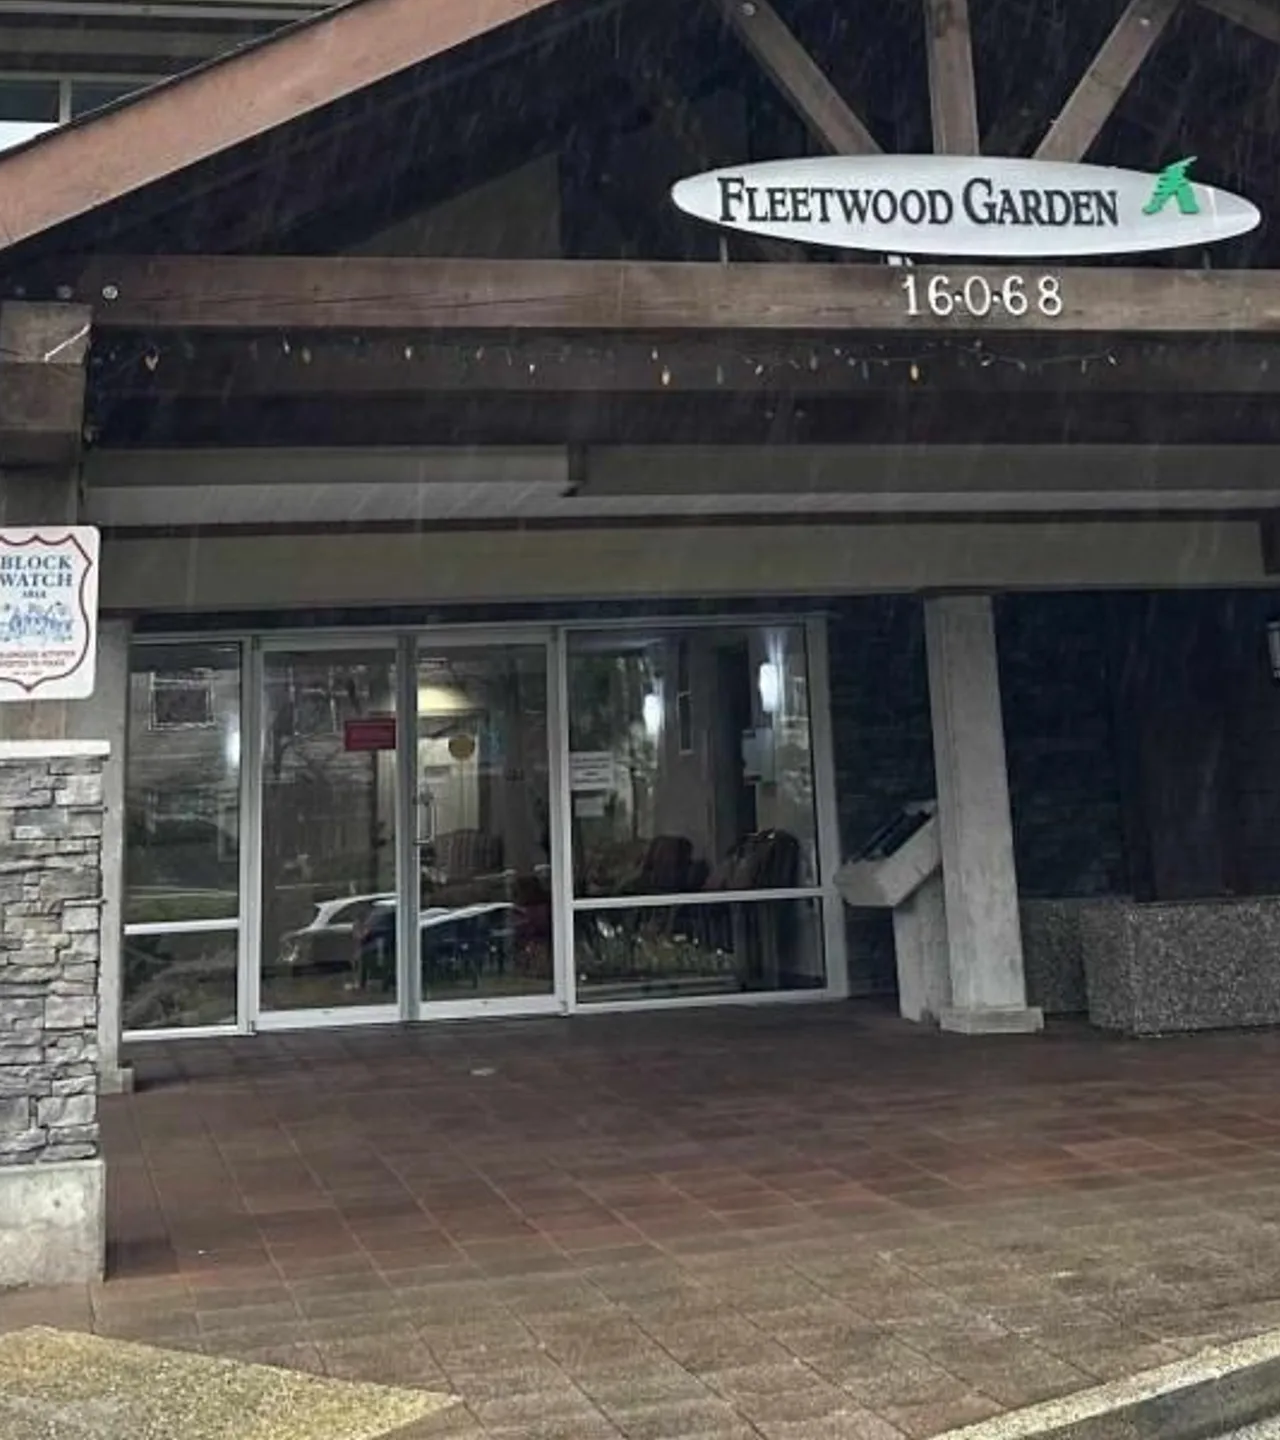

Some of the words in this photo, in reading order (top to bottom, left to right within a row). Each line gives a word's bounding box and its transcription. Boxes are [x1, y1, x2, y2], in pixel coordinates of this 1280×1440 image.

[717, 177, 953, 225] FLEETWOOD
[963, 177, 1119, 226] GARDEN
[902, 275, 1063, 317] 16068
[0, 555, 72, 570] BLOCK
[0, 573, 73, 587] WATCH
